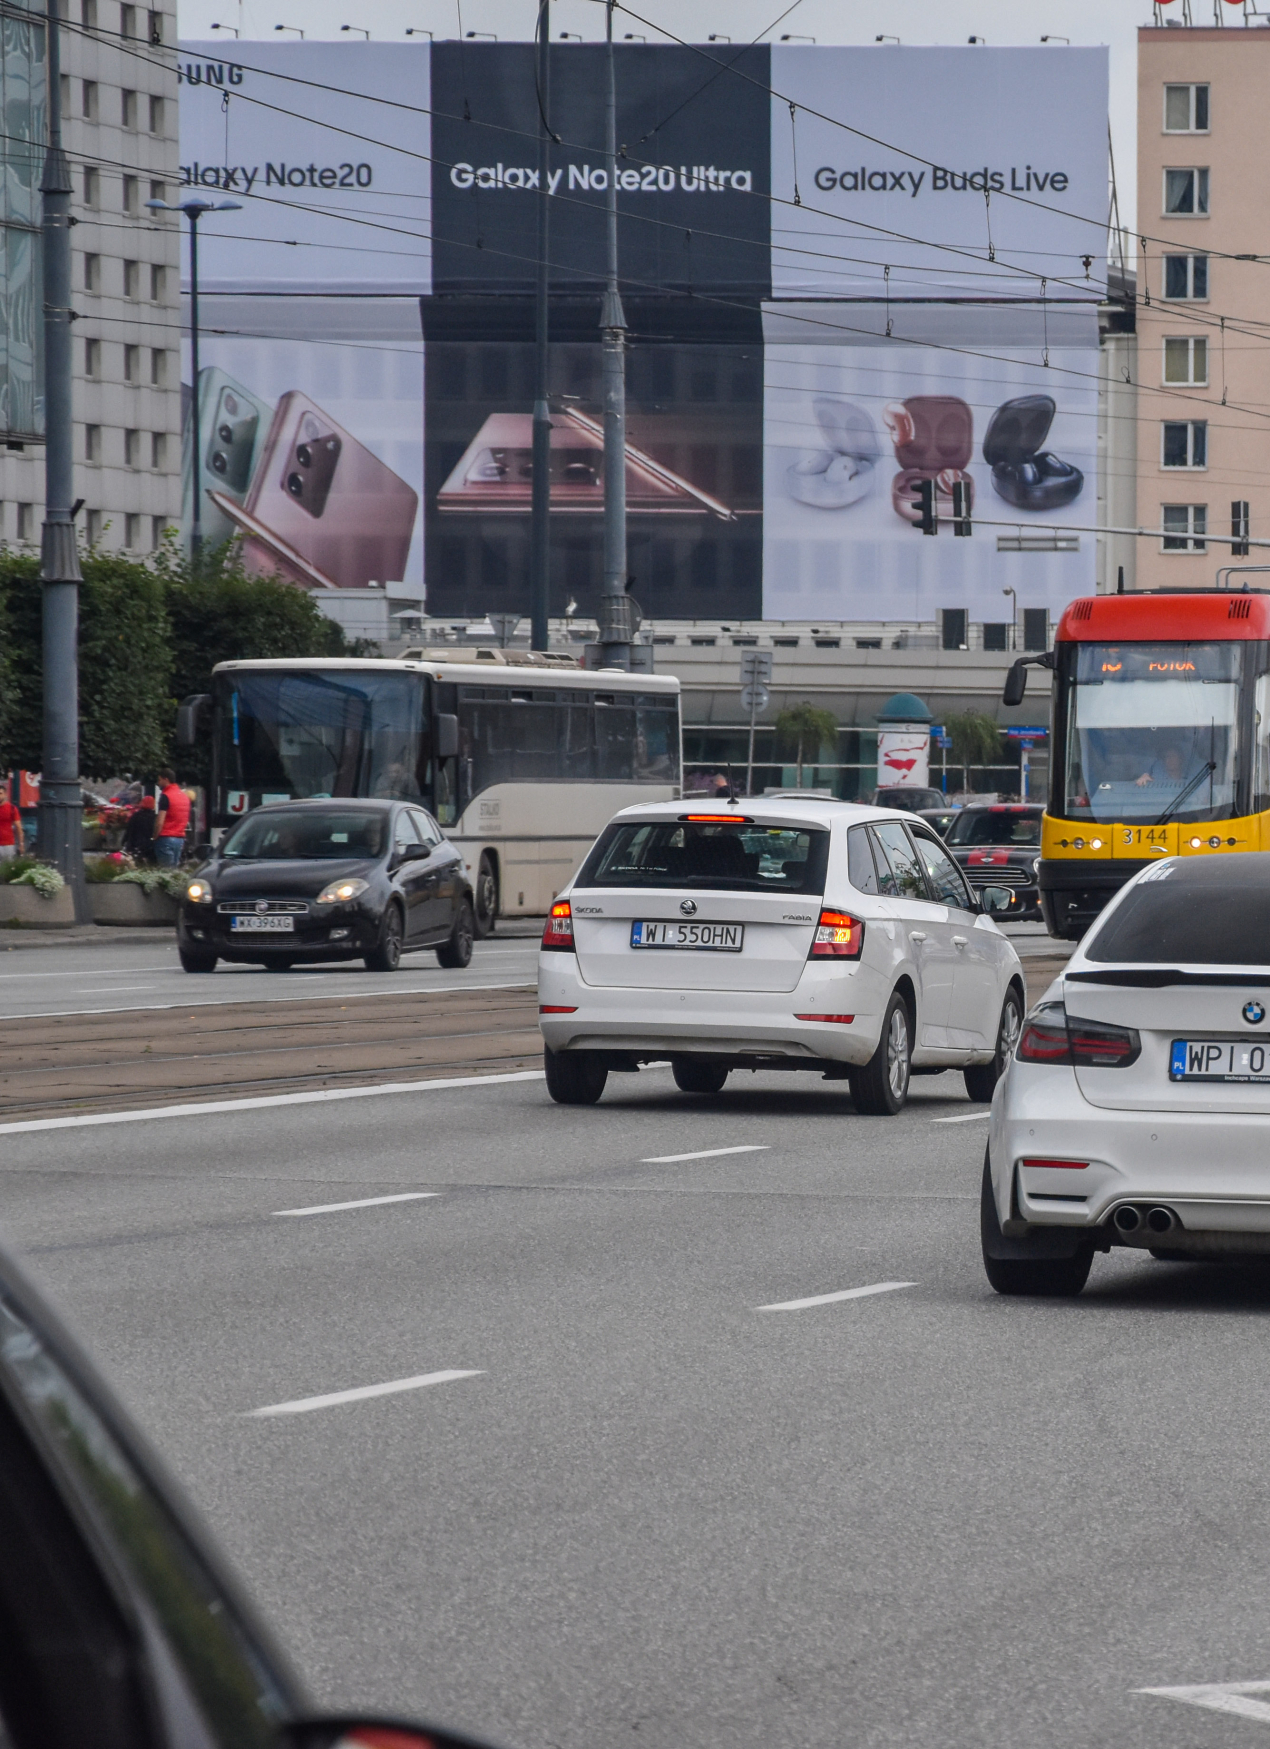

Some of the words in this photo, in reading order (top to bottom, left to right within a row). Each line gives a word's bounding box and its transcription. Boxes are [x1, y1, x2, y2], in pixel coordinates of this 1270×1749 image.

[265, 162, 372, 188] Note20
[450, 162, 563, 195] Galaxy
[568, 164, 675, 192] Note20
[680, 165, 752, 192] Ultra
[814, 166, 926, 198] Galaxy
[932, 166, 1005, 191] Buds
[1011, 165, 1069, 191] Live
[231, 794, 245, 812] J
[1122, 828, 1168, 845] 3144
[782, 914, 812, 922] FABIA
[646, 924, 666, 943] WI
[1174, 1062, 1184, 1070] PL
[1188, 1045, 1235, 1073] WPI
